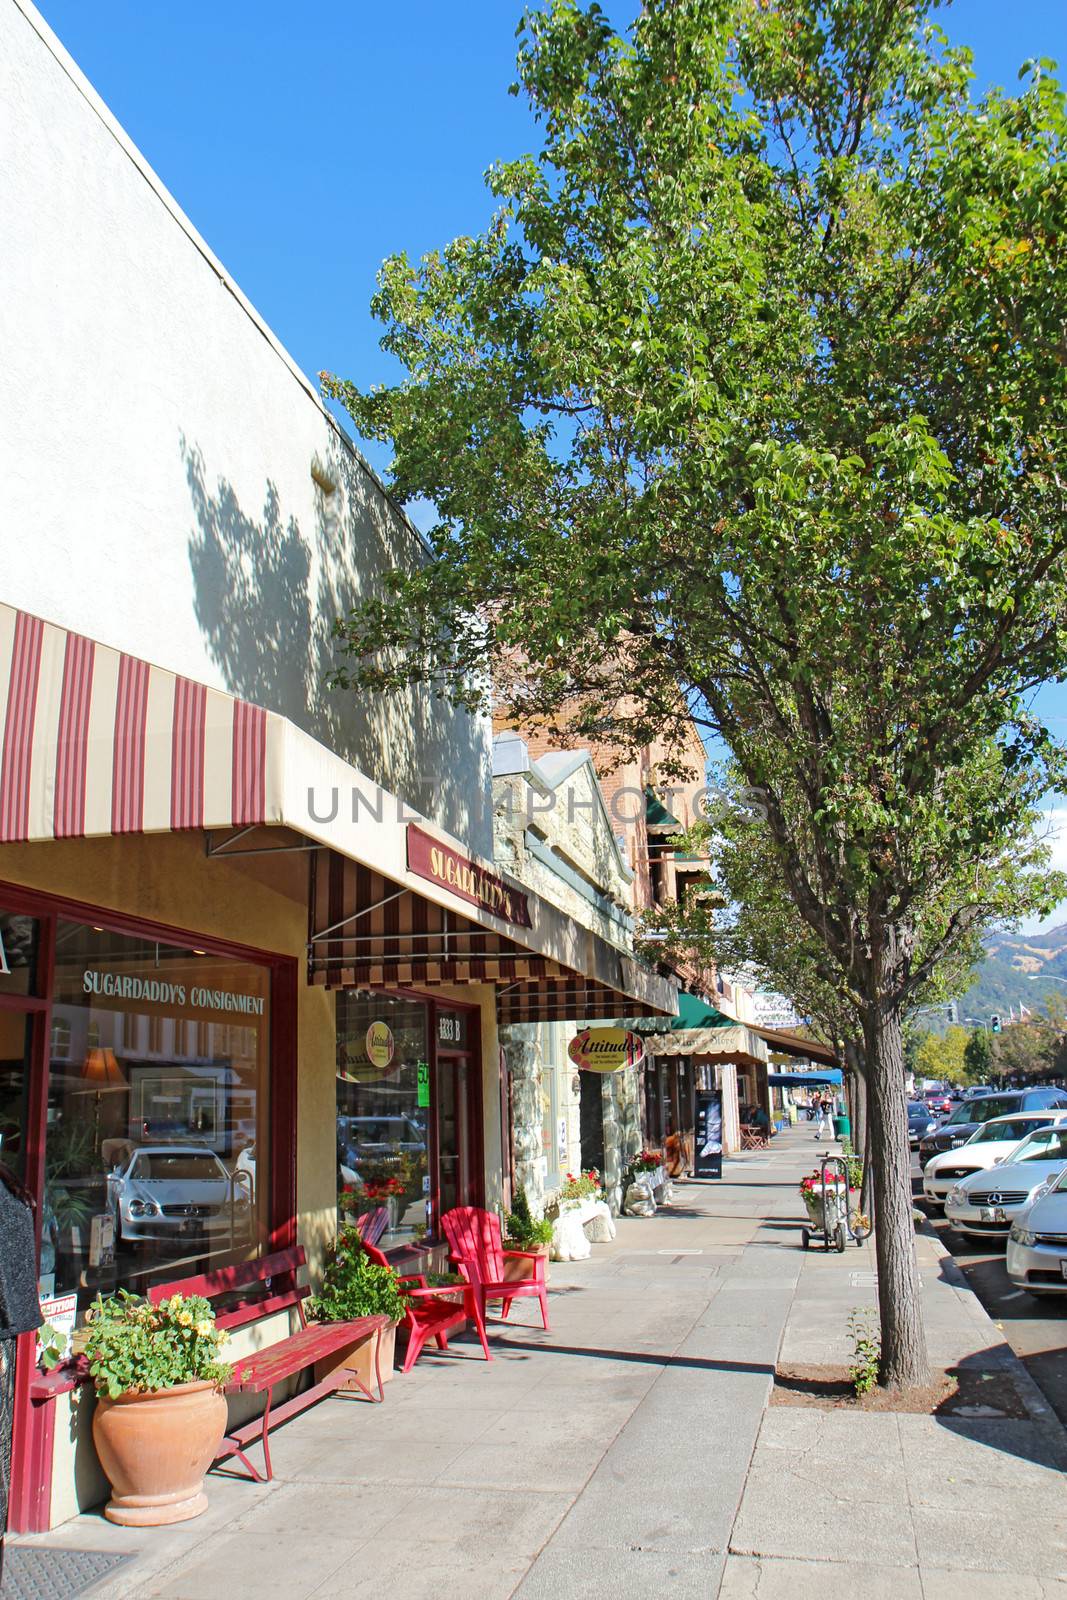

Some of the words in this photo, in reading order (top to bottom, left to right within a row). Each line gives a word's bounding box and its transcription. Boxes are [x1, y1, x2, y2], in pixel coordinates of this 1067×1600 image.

[82, 969, 186, 1007] SUGARDADDY'S
[190, 986, 265, 1016] CONSIGNMENT
[455, 1020, 461, 1041] B
[571, 1037, 639, 1054] Attitudes
